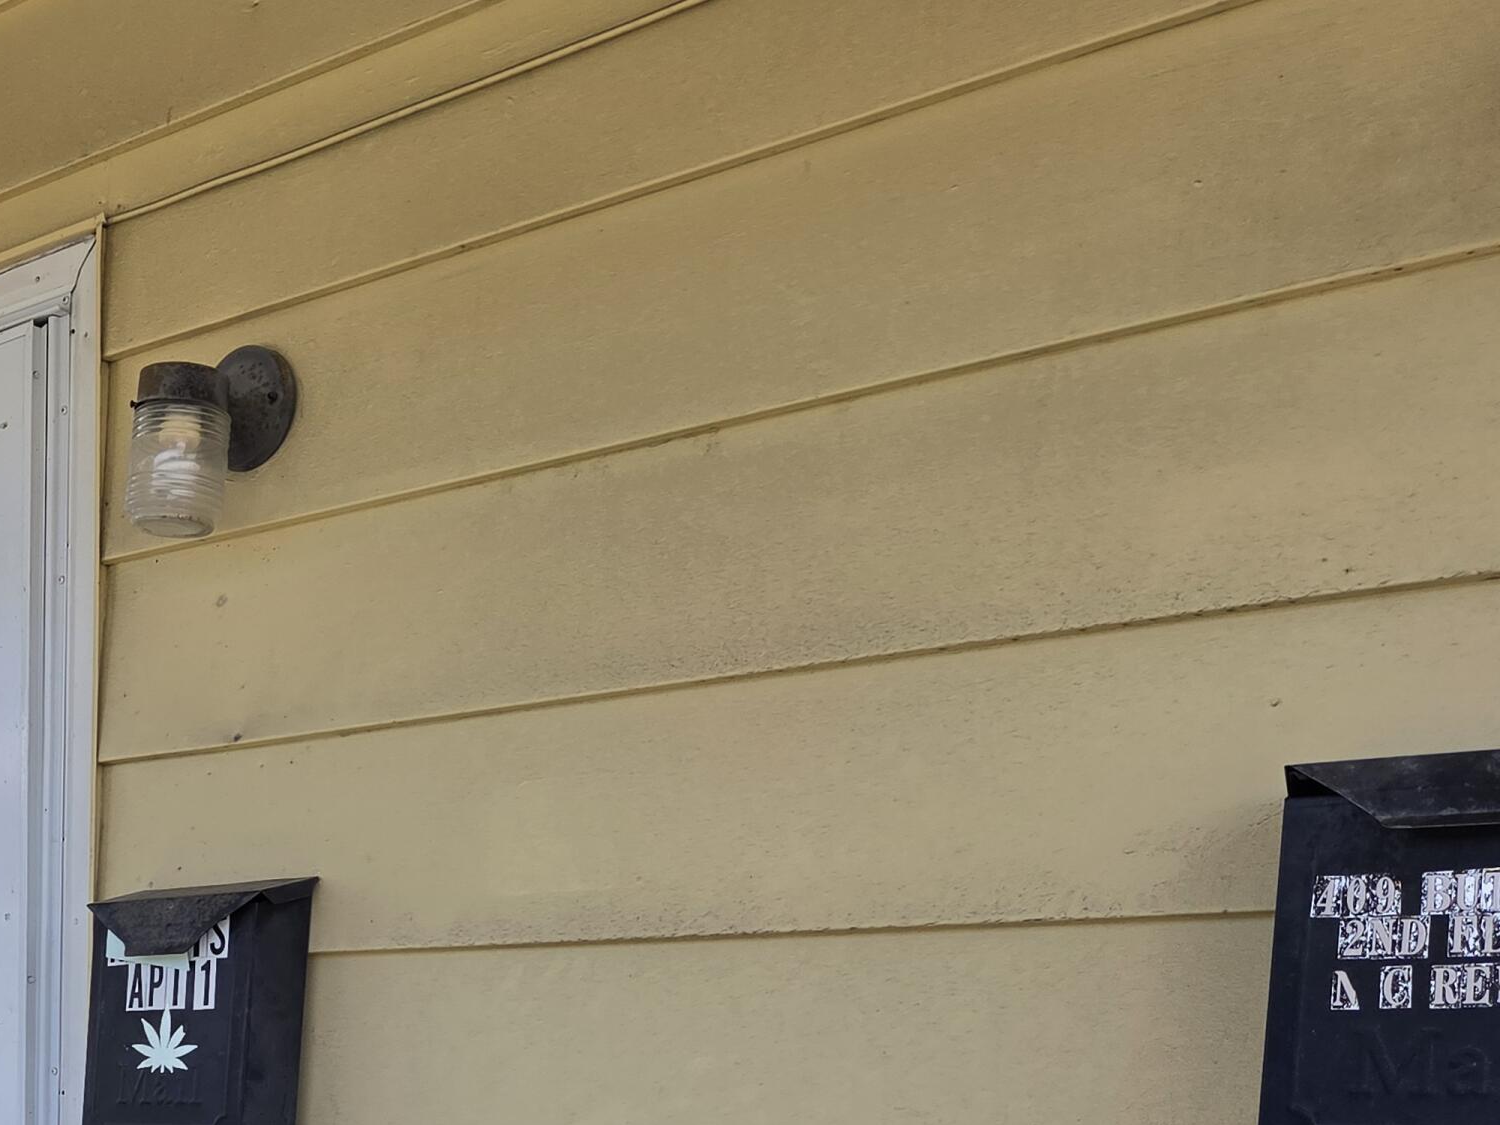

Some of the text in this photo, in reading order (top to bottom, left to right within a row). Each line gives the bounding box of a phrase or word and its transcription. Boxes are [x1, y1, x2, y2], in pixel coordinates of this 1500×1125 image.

[1316, 876, 1396, 916] 409
[1342, 918, 1427, 957] 2ND
[200, 960, 211, 1007] 1
[1383, 968, 1408, 1007] C
[1431, 966, 1500, 1006] RE
